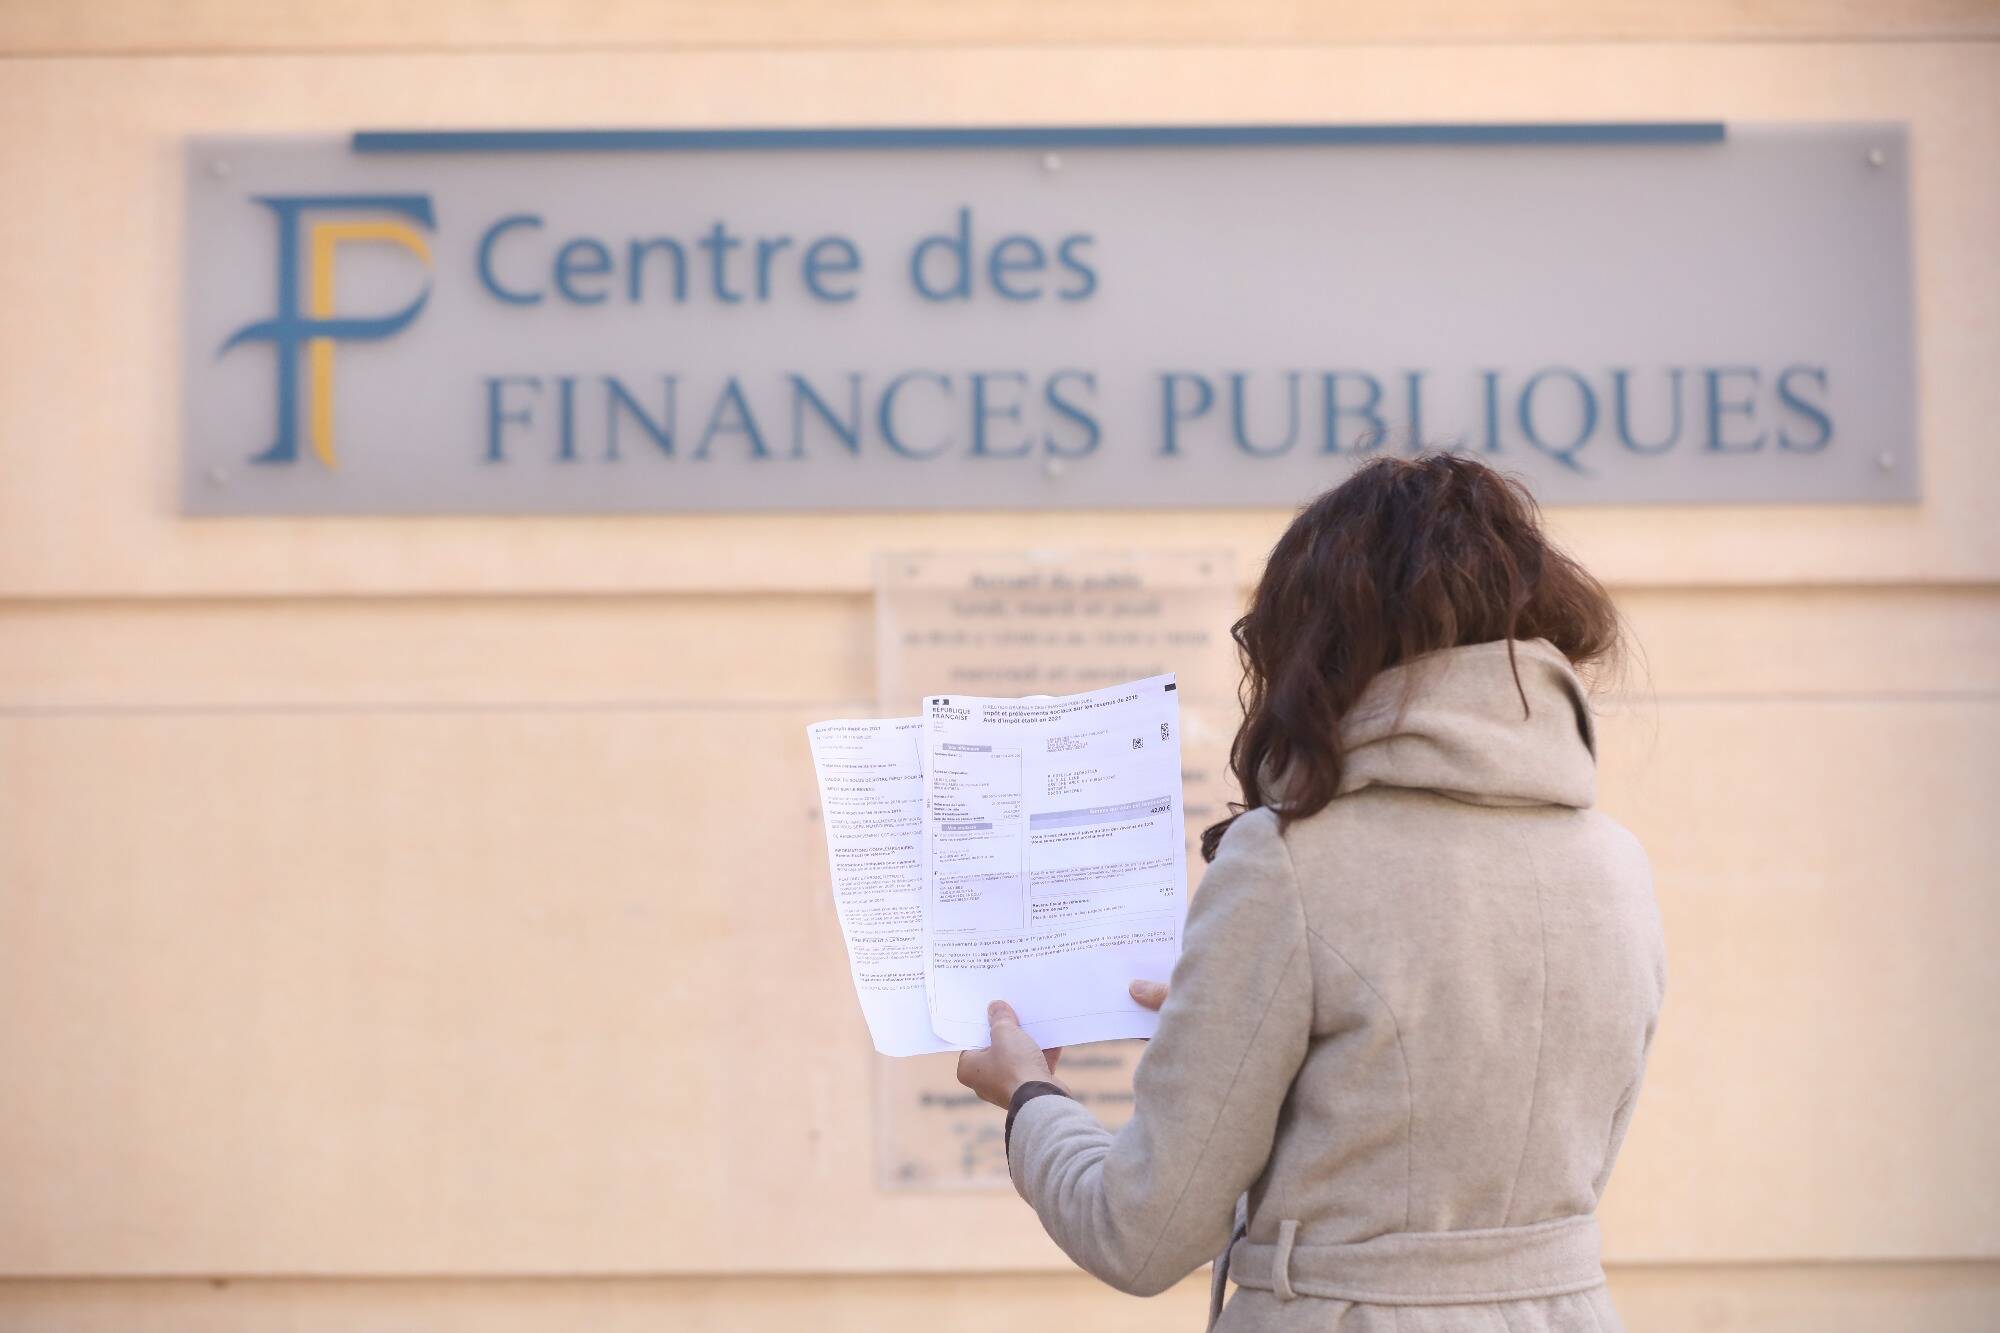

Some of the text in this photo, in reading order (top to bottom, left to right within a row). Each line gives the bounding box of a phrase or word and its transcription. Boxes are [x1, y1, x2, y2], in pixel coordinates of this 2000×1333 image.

[475, 206, 1099, 307] Centre des
[480, 366, 1836, 475] FINANCES PUBLIQUES
[932, 707, 971, 715] RÉPUBLIQUE
[932, 713, 968, 721] FRANÇAISE
